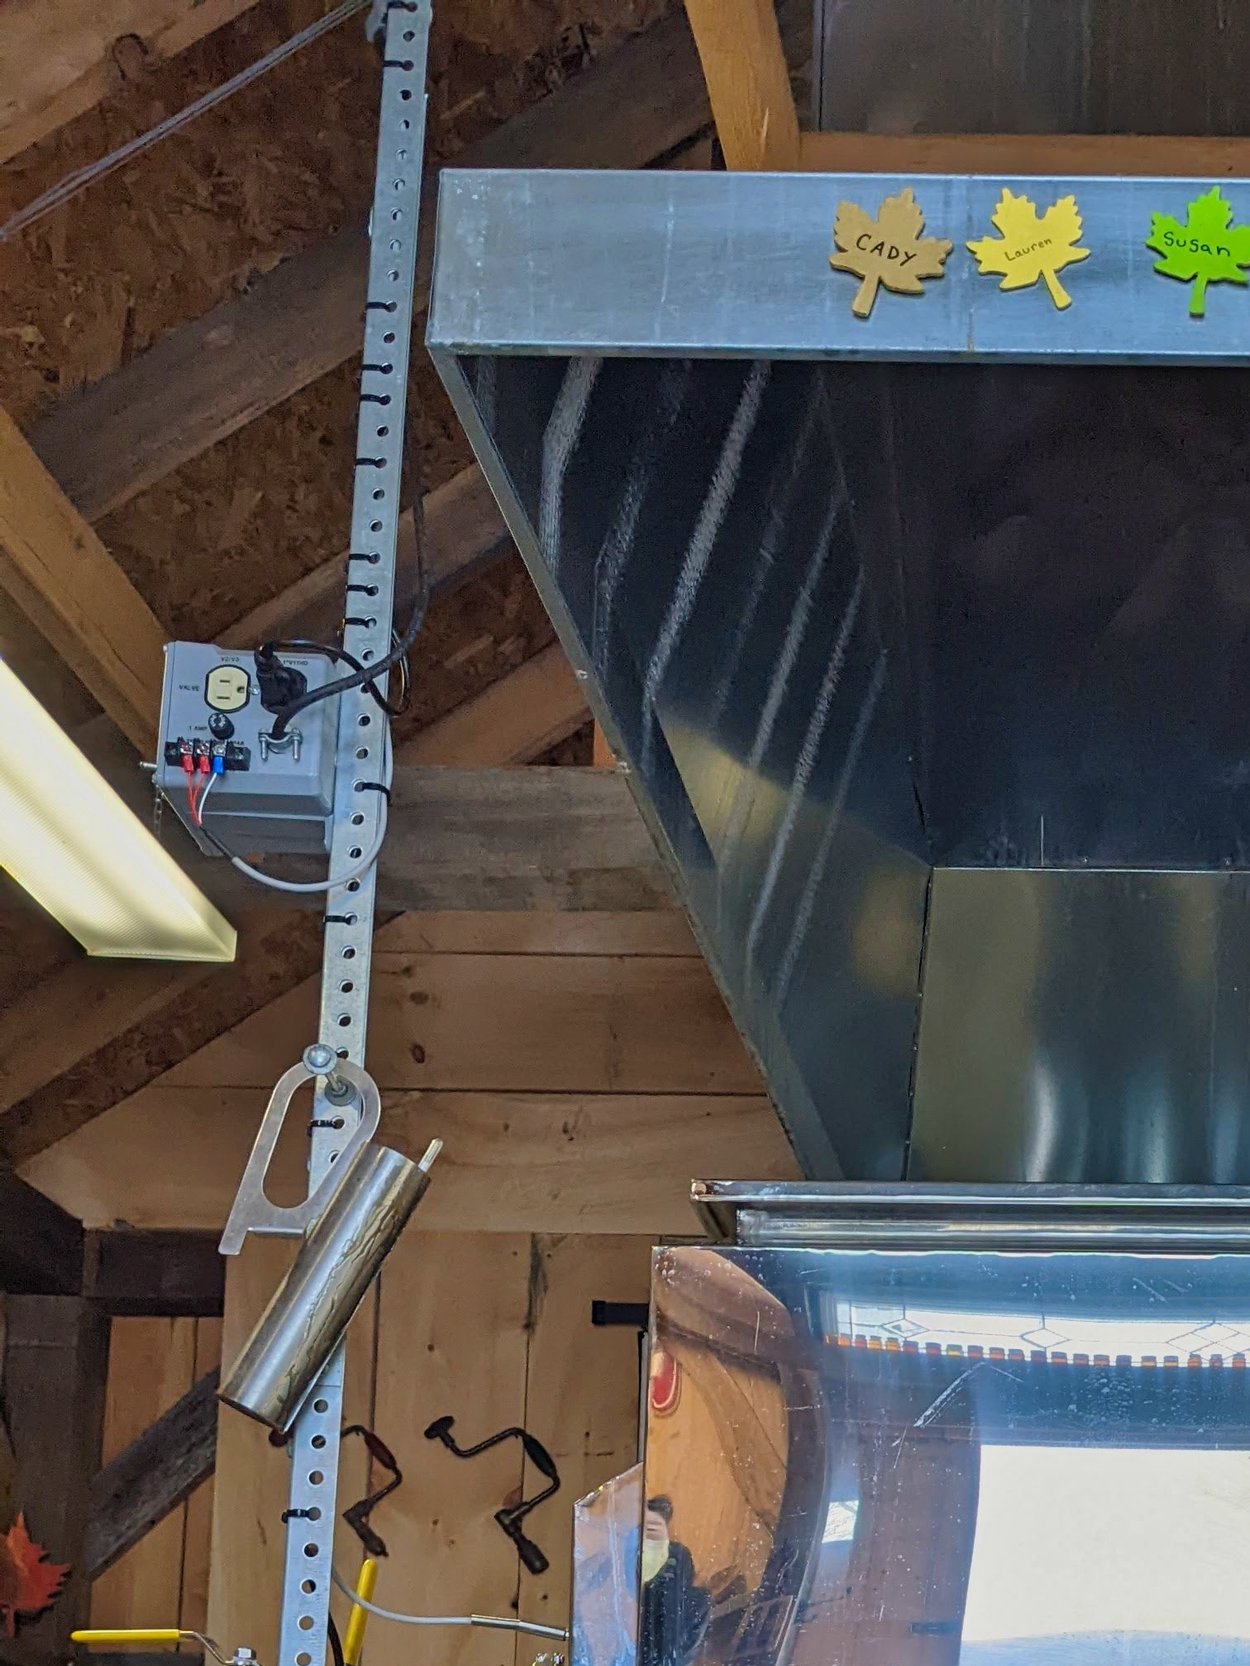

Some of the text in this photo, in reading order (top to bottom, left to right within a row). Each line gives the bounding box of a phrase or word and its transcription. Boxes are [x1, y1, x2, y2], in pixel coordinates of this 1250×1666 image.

[856, 233, 917, 266] CADY
[1004, 238, 1052, 261] Lauren
[1163, 231, 1231, 257] Susan
